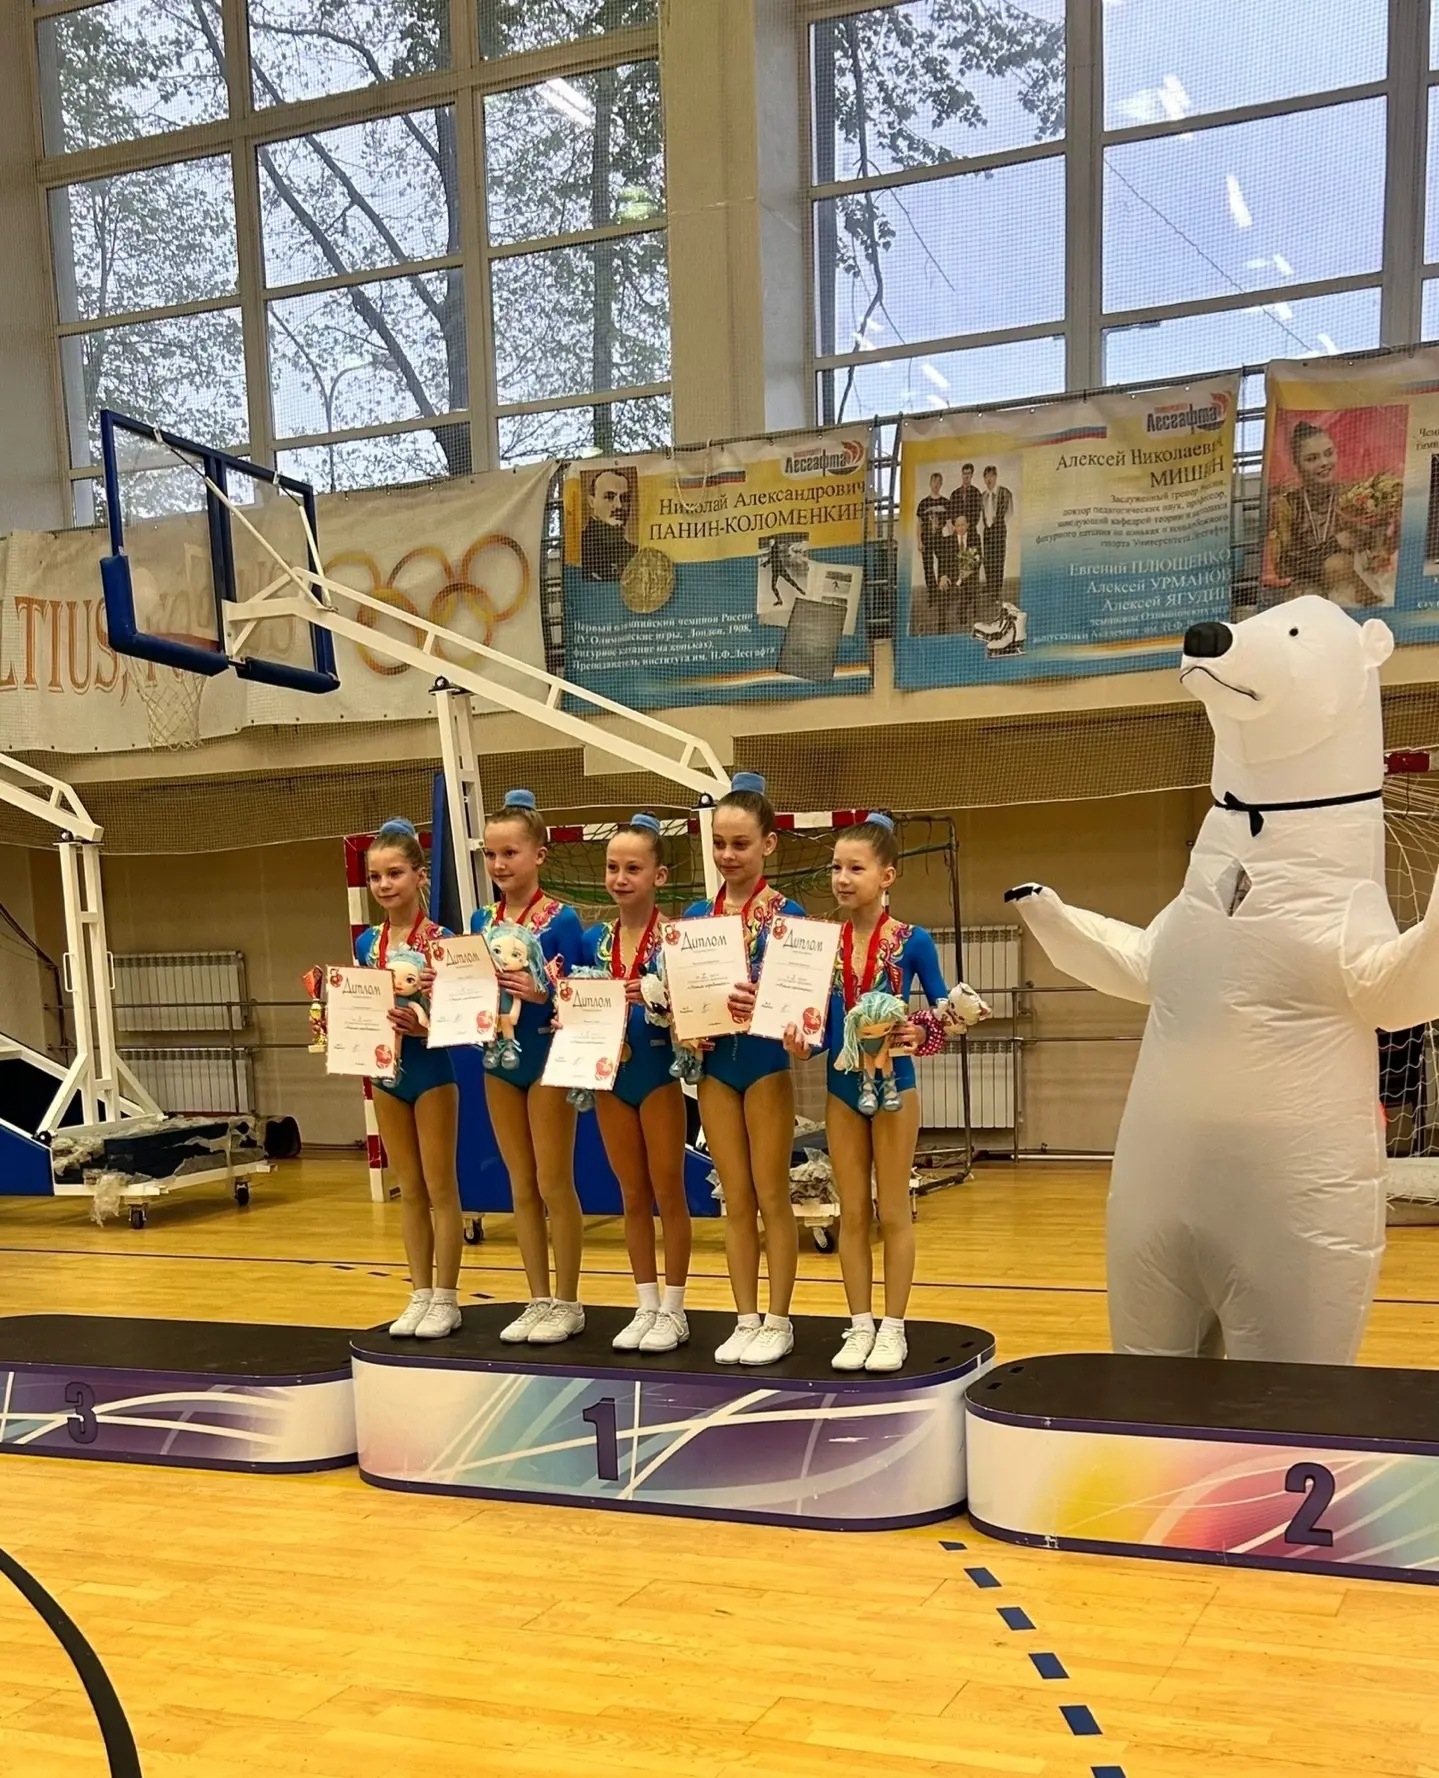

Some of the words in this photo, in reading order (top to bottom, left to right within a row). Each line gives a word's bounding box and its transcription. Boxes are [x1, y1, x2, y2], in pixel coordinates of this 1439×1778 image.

[785, 449, 847, 477] Лесгафта
[1056, 450, 1126, 471] Алексей
[1131, 436, 1224, 466] Николаев
[659, 493, 728, 515] Николай
[733, 481, 865, 508] Александрович
[649, 501, 864, 541] ПАНИН-КОЛОМЕНКИН
[1070, 563, 1127, 576] Евгений
[1131, 549, 1231, 574] ПЛЮЩЕНКО
[1086, 580, 1145, 593] Алексей
[1102, 597, 1161, 612] Алексей
[573, 621, 612, 634] Первый
[0, 596, 125, 707] TIUS,
[681, 931, 728, 951] Диплом
[342, 976, 381, 995] Диплом
[572, 990, 612, 1008] Диплом
[65, 1382, 98, 1443] 3
[583, 1397, 619, 1481] 1
[1284, 1462, 1336, 1547] 2
